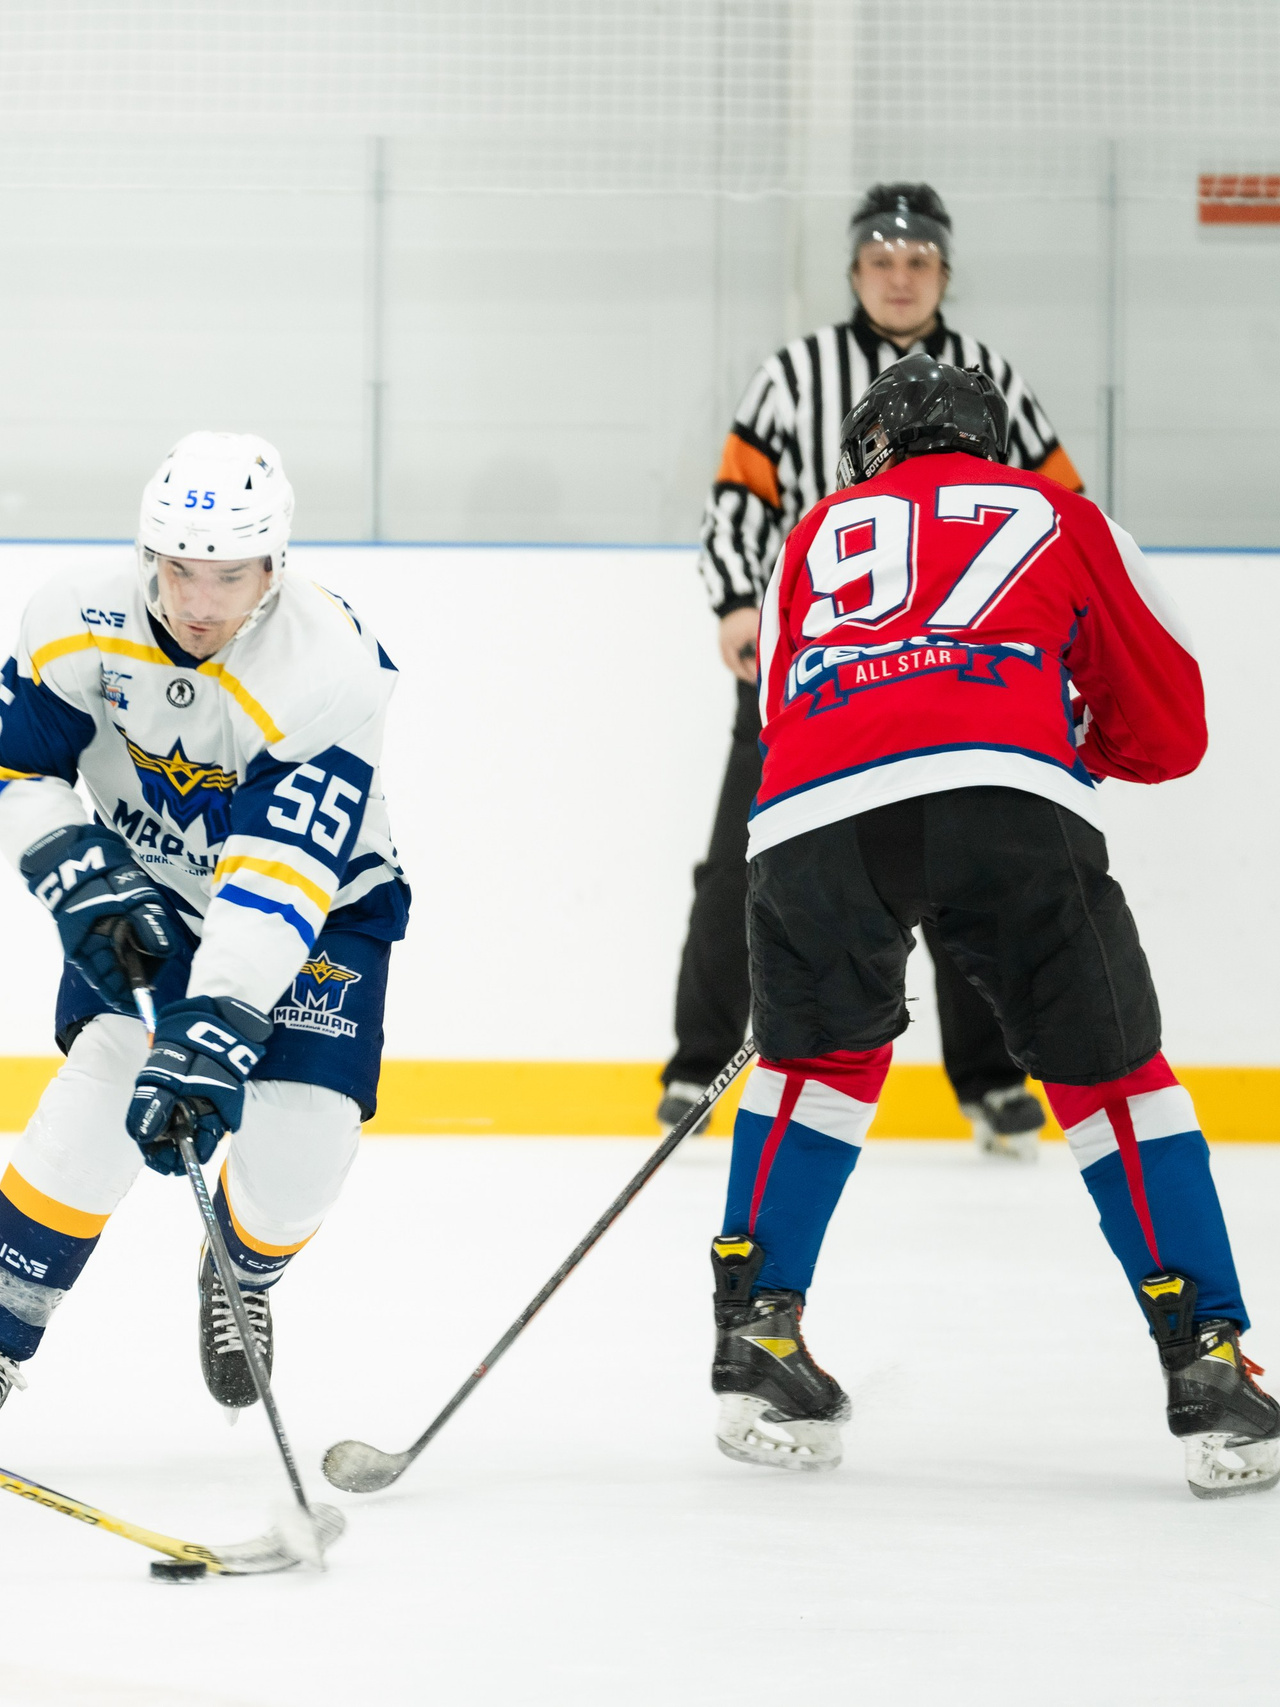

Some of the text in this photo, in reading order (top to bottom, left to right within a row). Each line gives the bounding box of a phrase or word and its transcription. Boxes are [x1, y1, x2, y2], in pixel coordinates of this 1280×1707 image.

[865, 448, 889, 478] SOYUZ
[184, 490, 216, 510] 55
[802, 484, 1061, 638] 97
[855, 649, 952, 684] ALL STAR
[266, 762, 362, 858] 55
[35, 845, 107, 911] CM
[276, 1007, 354, 1035] МАРШАЛ
[163, 1049, 187, 1062] PRO
[186, 1021, 259, 1076] CC
[705, 1037, 757, 1103] SOYUZ
